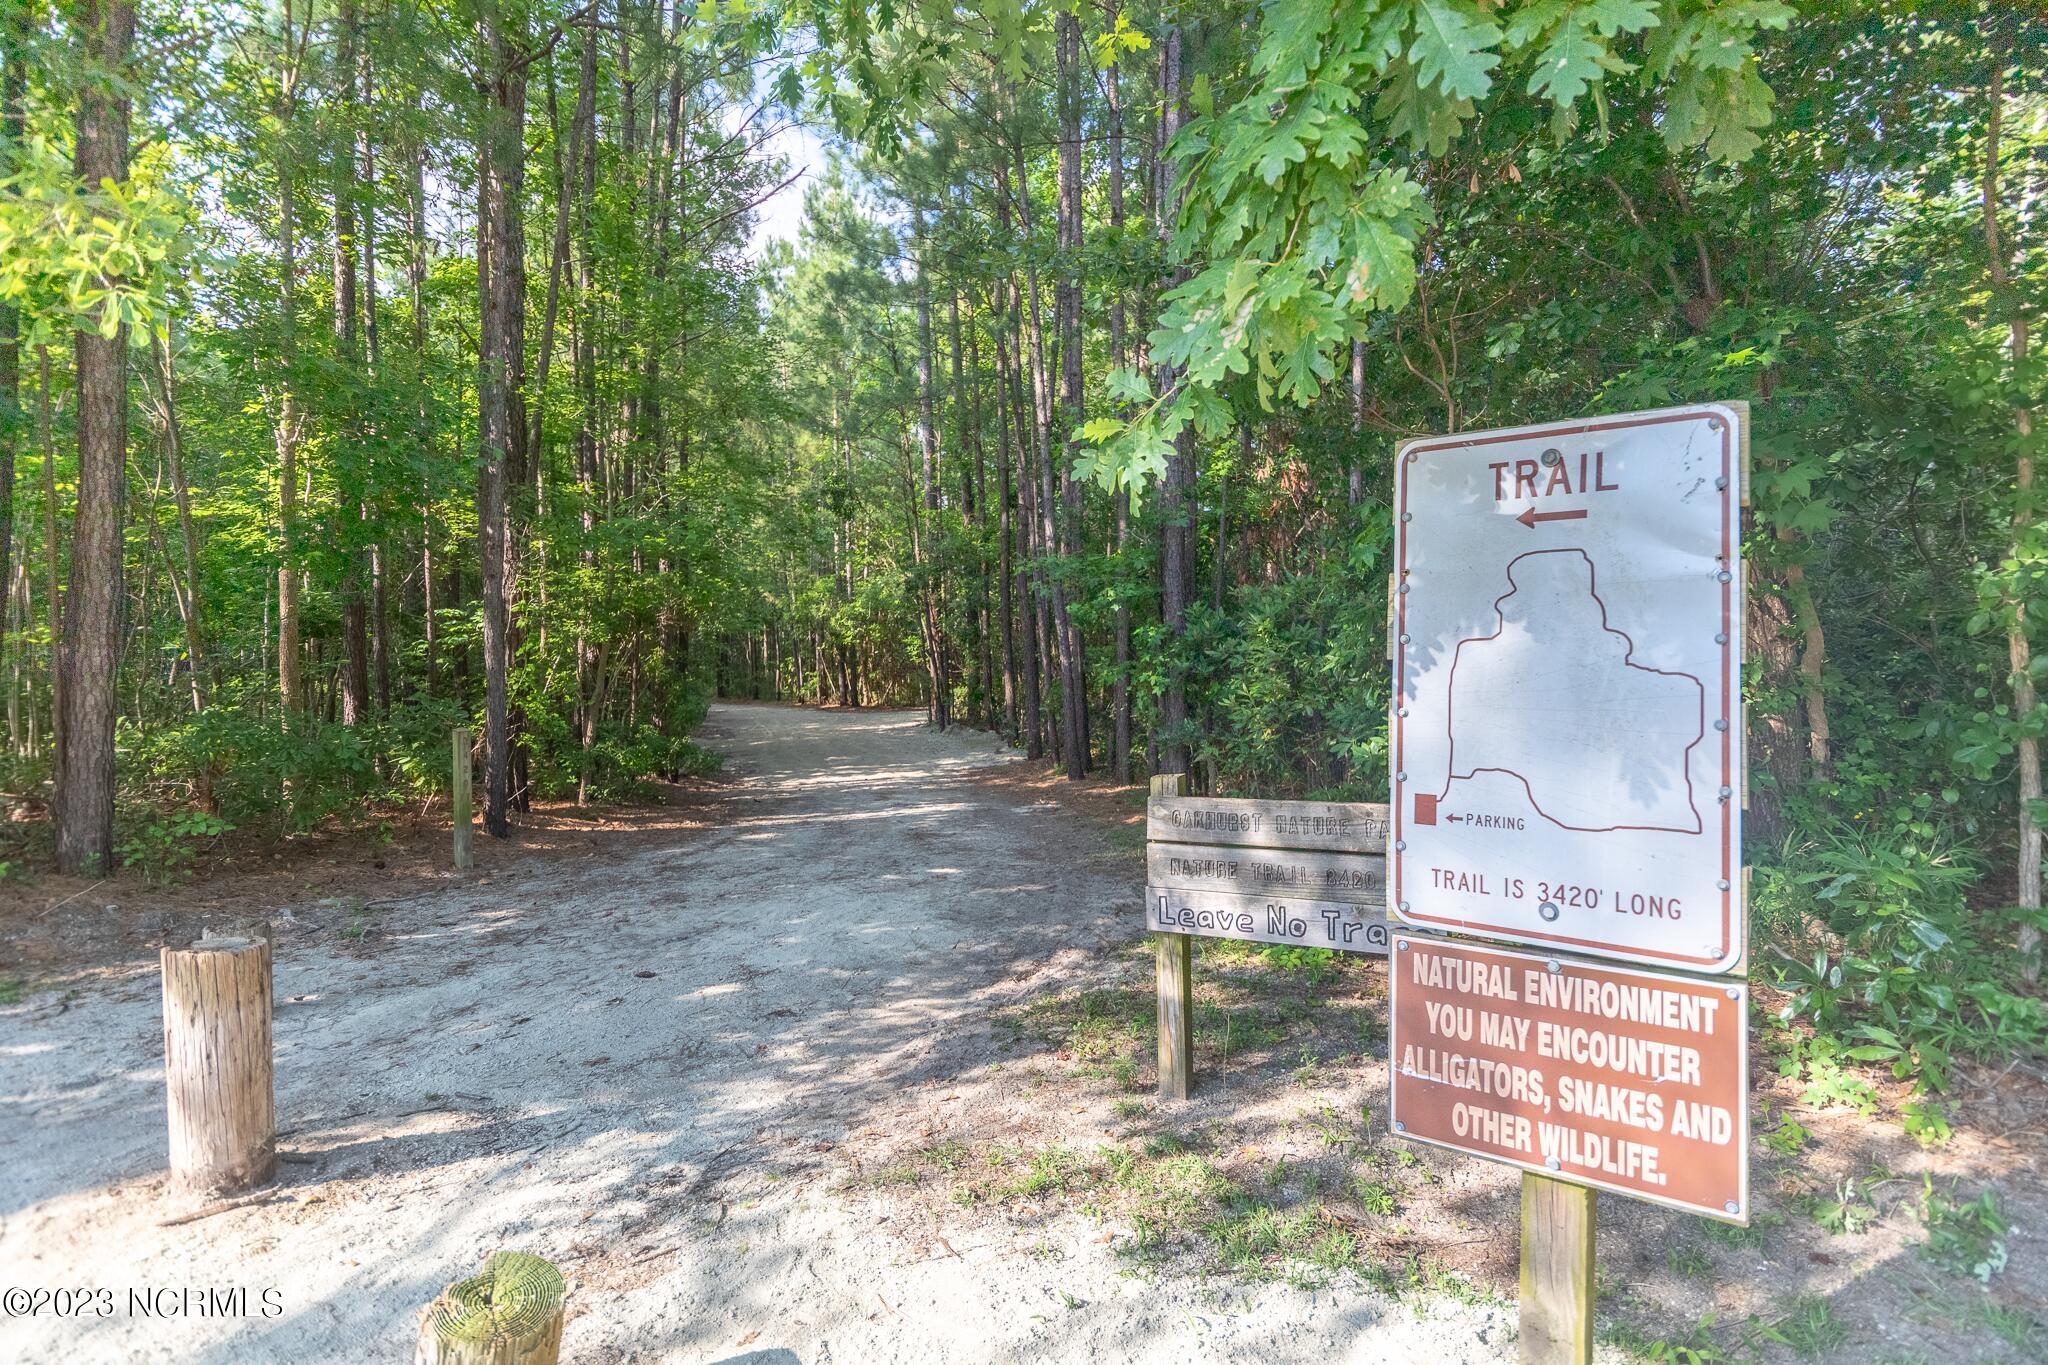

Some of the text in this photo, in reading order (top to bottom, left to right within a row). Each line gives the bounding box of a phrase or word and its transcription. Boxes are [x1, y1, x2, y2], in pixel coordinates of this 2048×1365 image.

[1488, 452, 1619, 501] TRAIL
[1171, 809, 1263, 833] OAKHURST
[1275, 814, 1350, 837] NATURE
[1466, 813, 1525, 831] PARKING
[1170, 857, 1238, 880] NATURE
[1251, 862, 1312, 885] TRAIL
[1431, 868, 1491, 895] TRAIL
[1505, 877, 1524, 899] IS
[1615, 891, 1682, 920] LONG
[1158, 895, 1254, 933] Leave
[1267, 904, 1307, 937] No
[1413, 952, 1719, 1035] NATURAL ENVIRONMENT
[1425, 1001, 1701, 1086] YOU MAY ENCOUNTER
[1402, 1044, 1732, 1145] ALLIGATORS, SNAKES AND
[1452, 1103, 1667, 1186] OTHER WILDLIFE.
